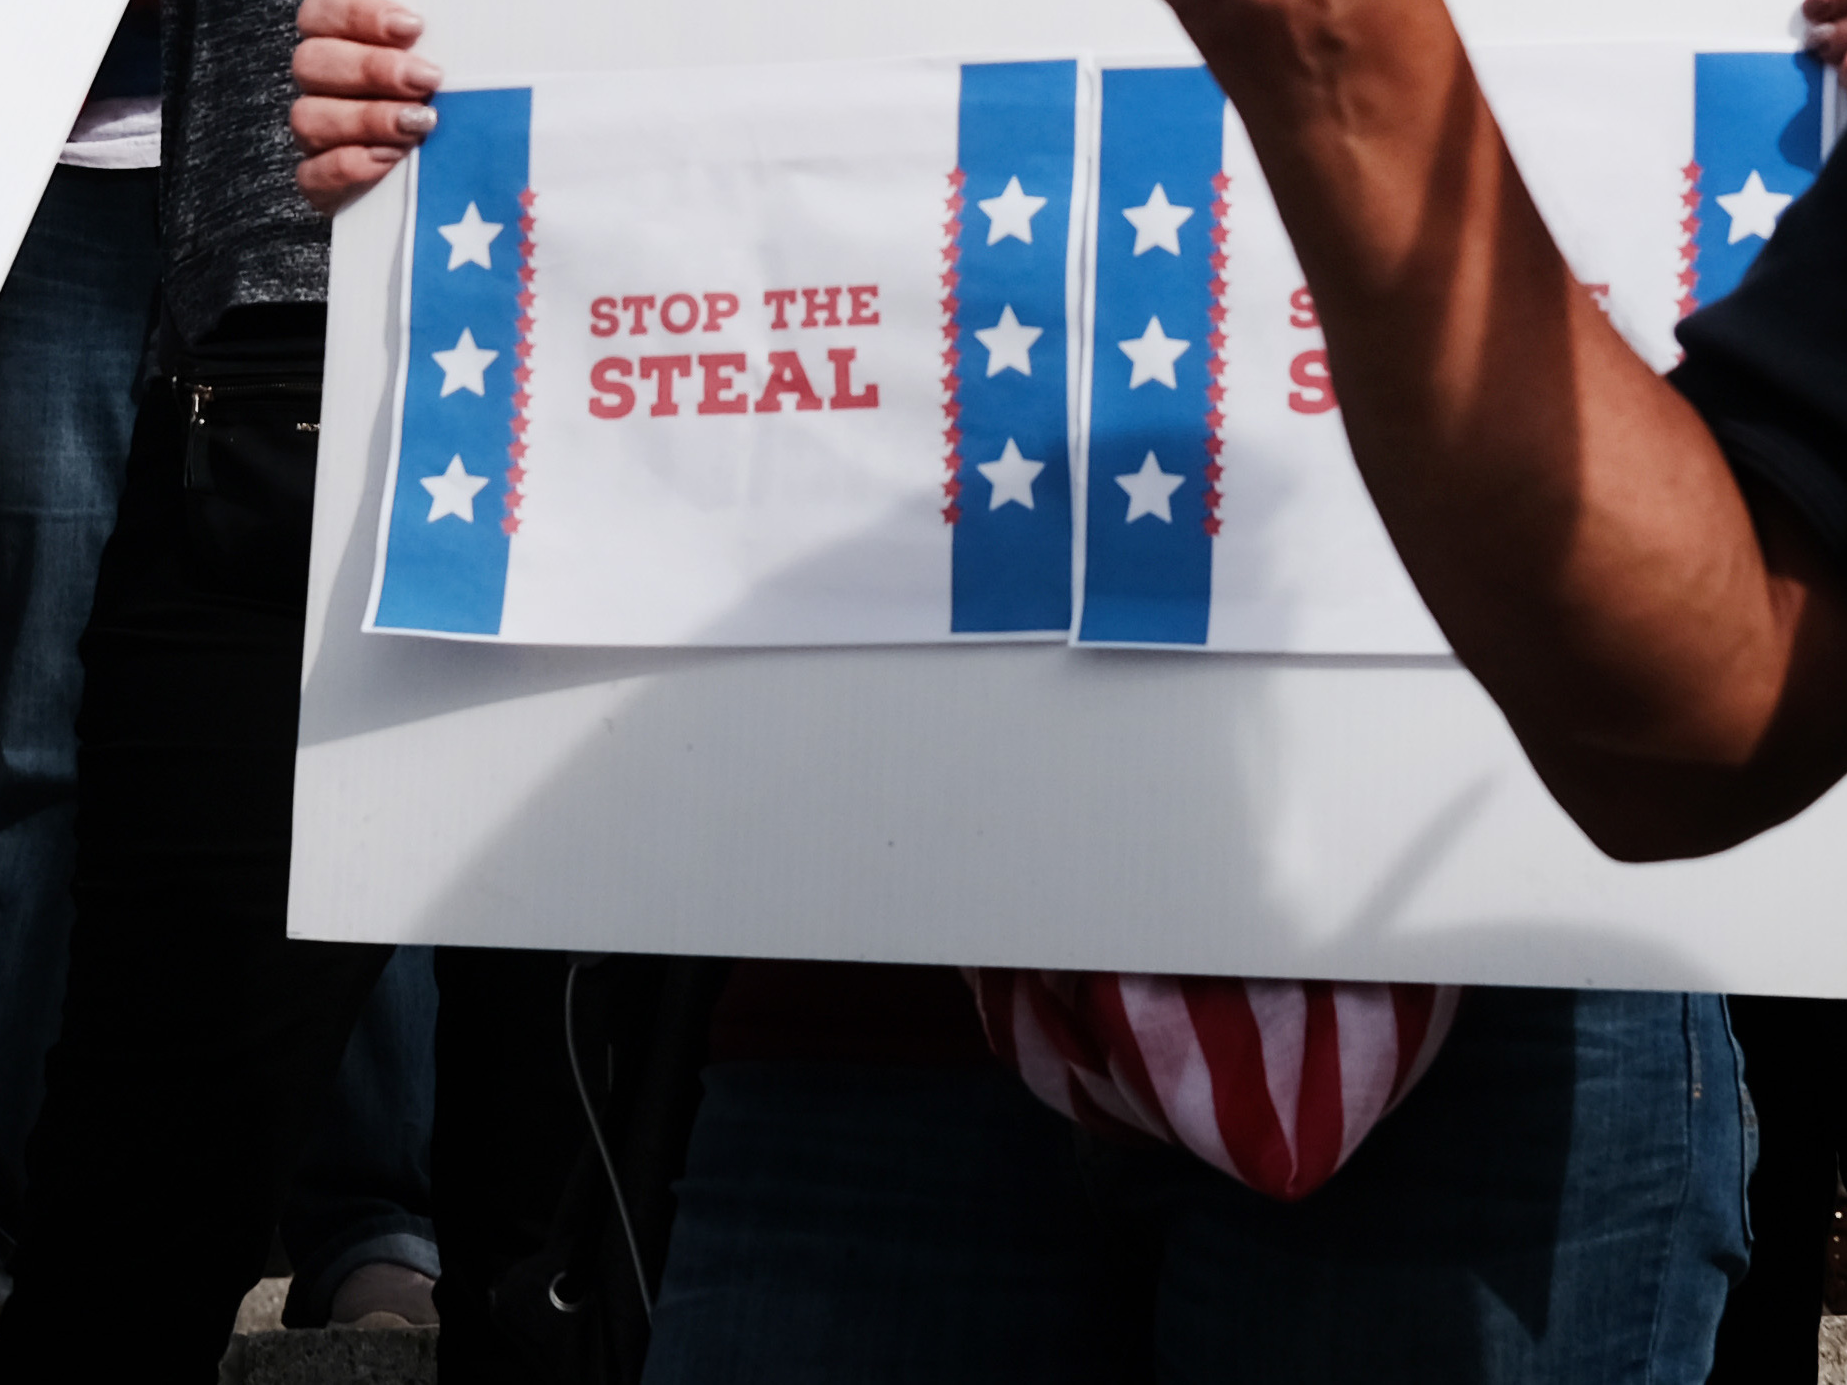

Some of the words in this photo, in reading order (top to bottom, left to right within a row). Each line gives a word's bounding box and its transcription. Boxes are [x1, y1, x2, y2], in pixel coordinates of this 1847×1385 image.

[590, 292, 740, 340] STOP
[763, 285, 880, 330] THE
[588, 347, 880, 421] STEAL
